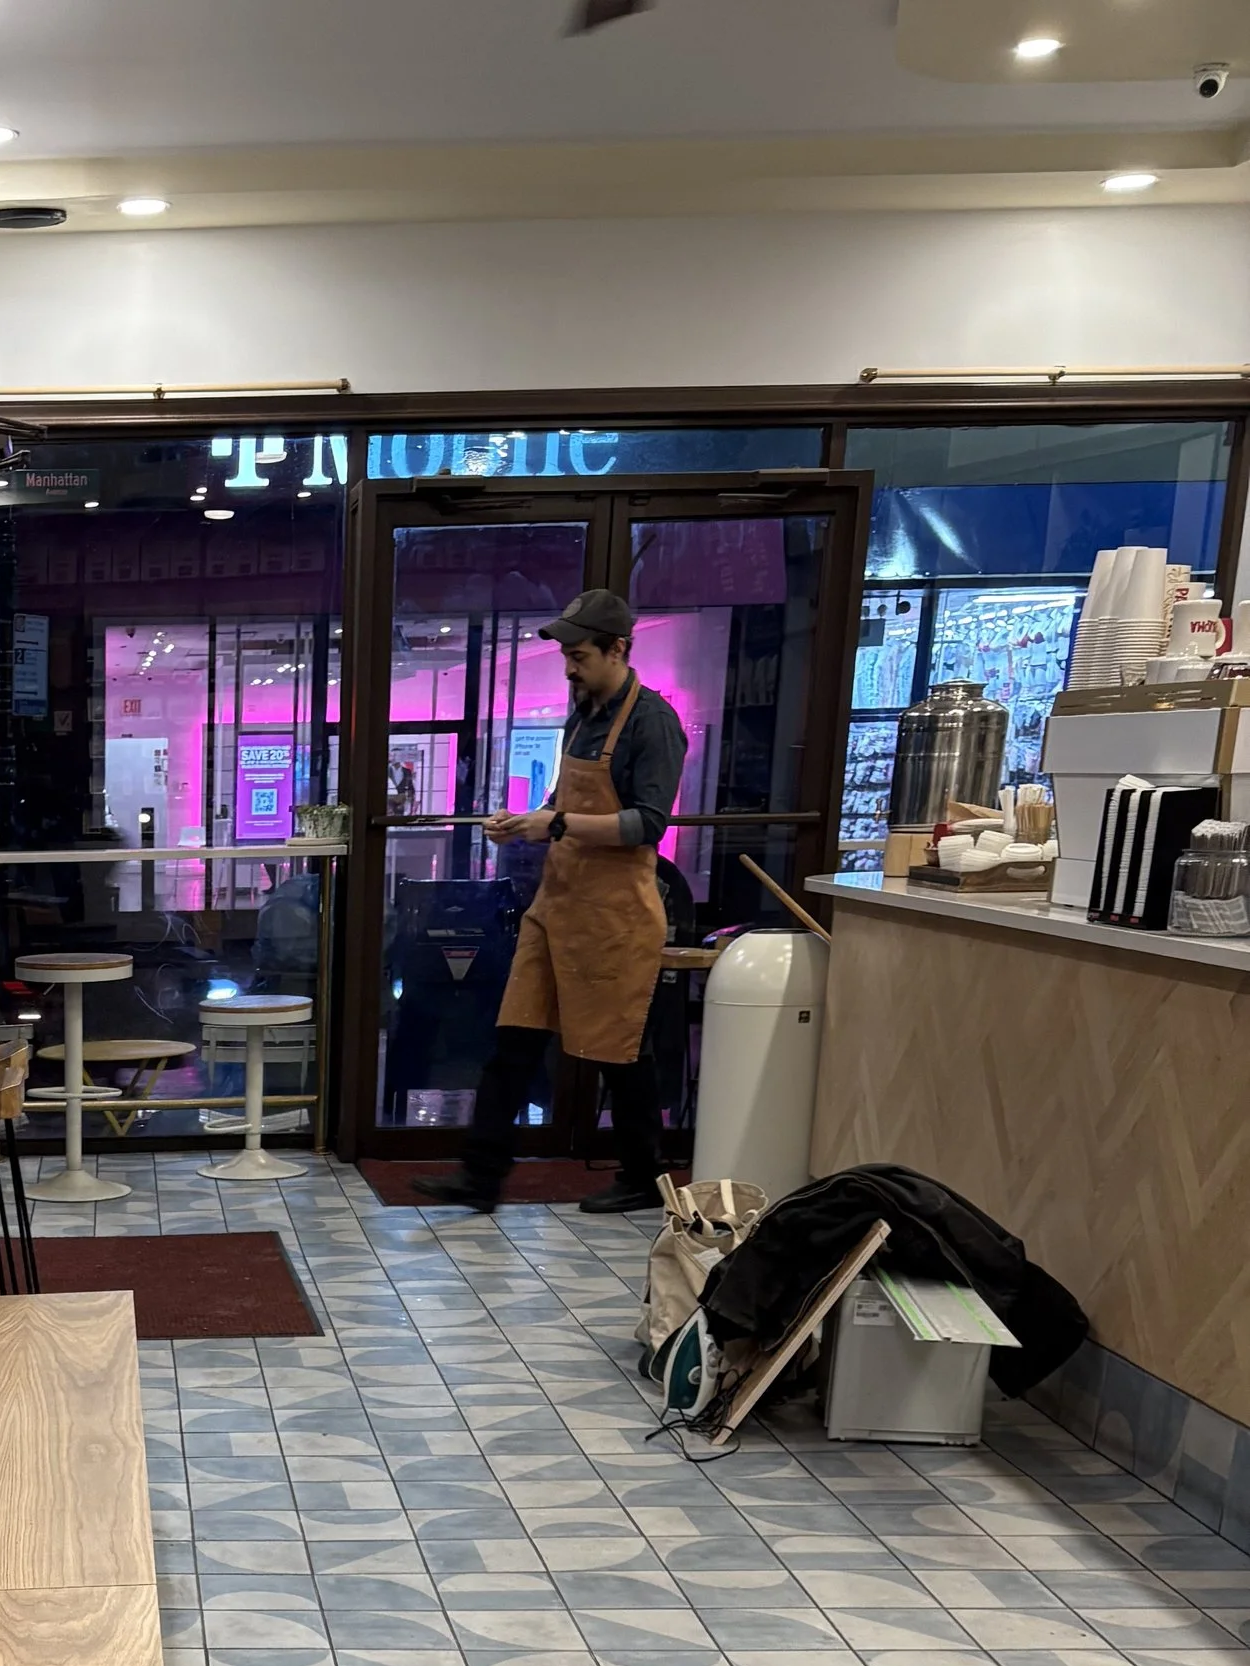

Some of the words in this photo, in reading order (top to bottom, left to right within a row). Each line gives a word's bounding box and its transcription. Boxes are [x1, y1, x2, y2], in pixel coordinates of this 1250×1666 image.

[26, 472, 88, 488] Manhattan
[123, 699, 141, 714] EXIT
[241, 750, 269, 761] SAVE
